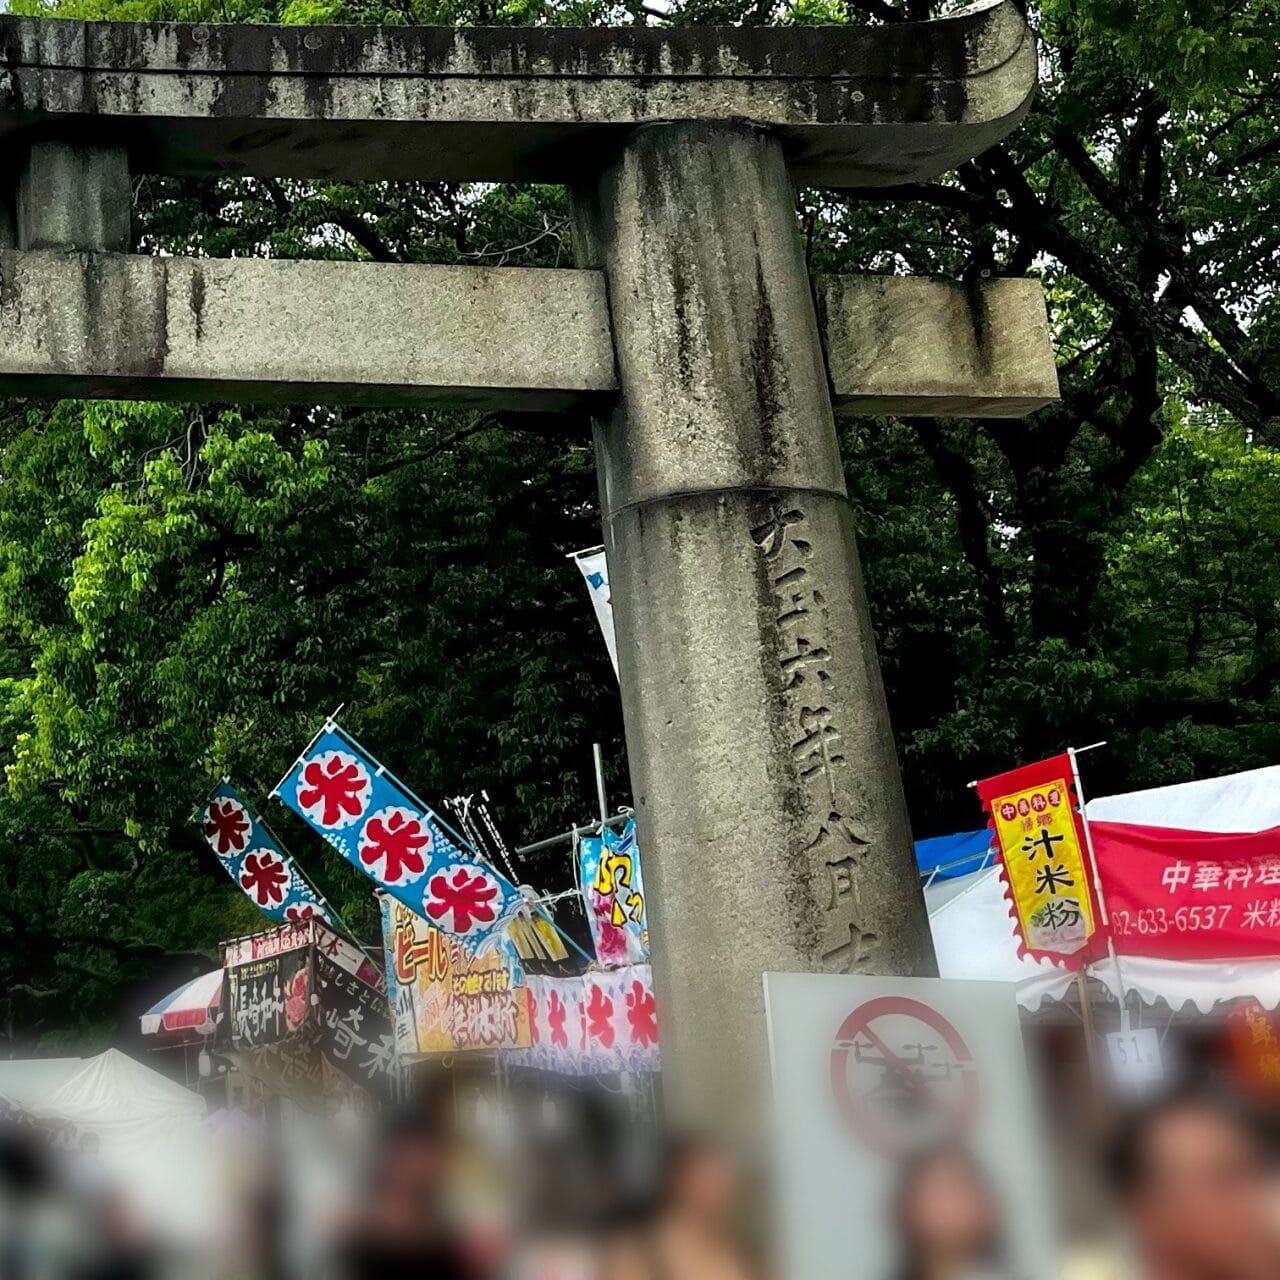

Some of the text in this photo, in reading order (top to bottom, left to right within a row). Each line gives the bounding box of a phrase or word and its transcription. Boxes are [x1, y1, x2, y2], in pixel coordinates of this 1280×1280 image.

[1021, 828, 1080, 930] 汁米粉
[396, 922, 449, 984] ビール
